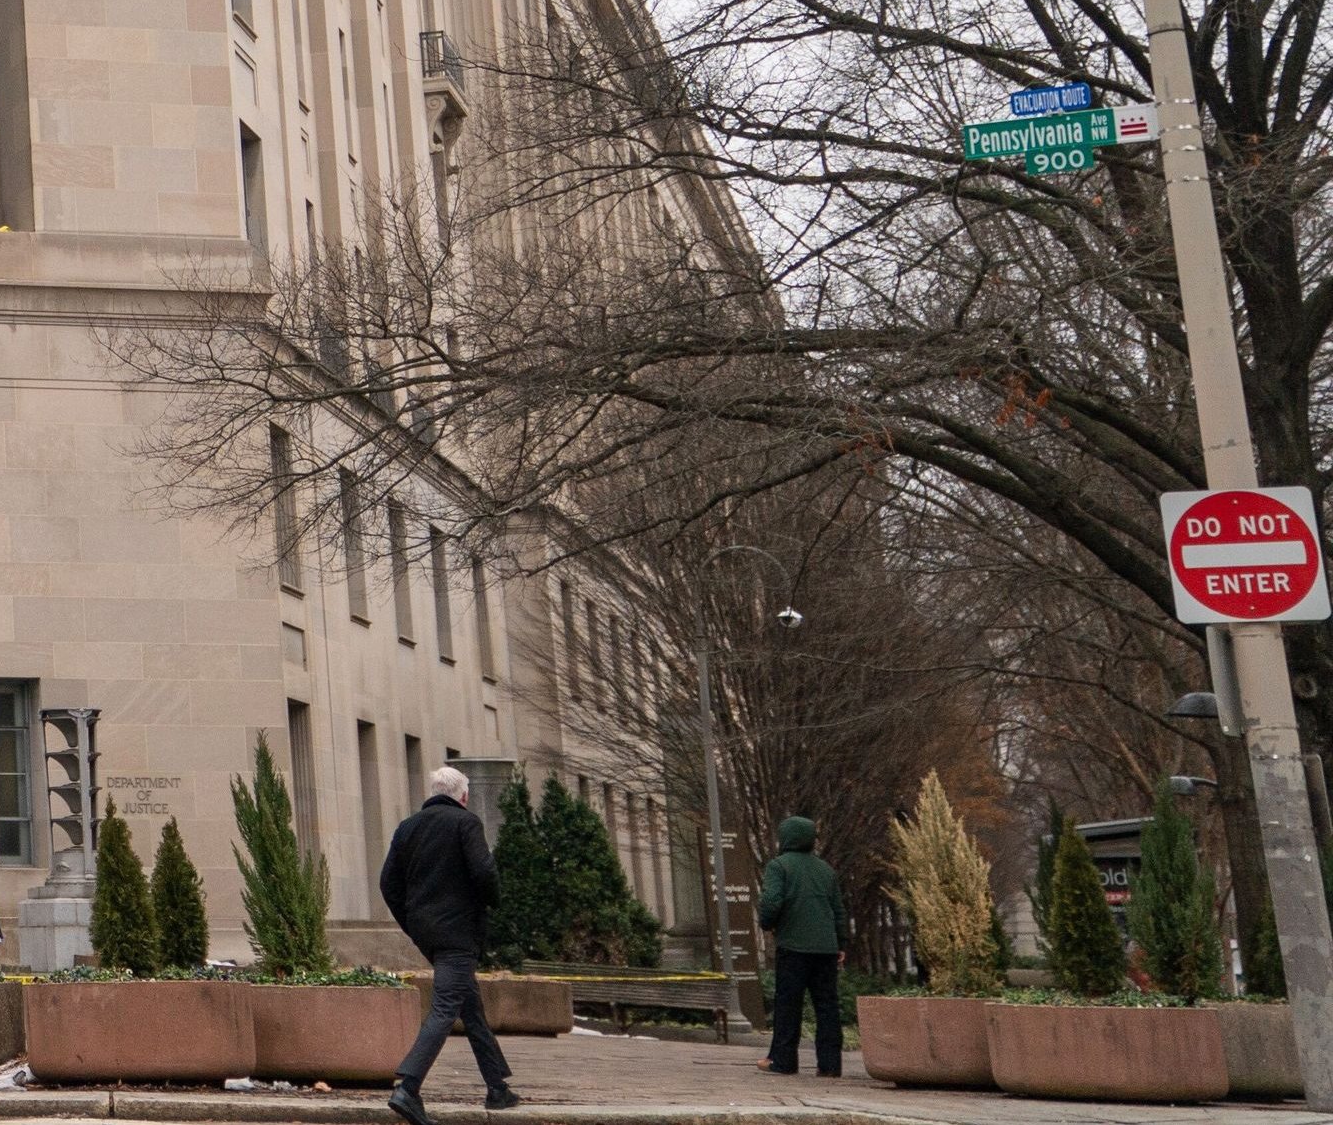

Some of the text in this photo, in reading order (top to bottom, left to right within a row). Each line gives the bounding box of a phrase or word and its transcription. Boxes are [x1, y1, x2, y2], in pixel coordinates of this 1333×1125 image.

[1014, 87, 1087, 113] EVACUATION ROUTE
[968, 114, 1108, 155] Pennsylvania Ave
[1091, 127, 1108, 140] NW
[1034, 150, 1085, 172] 900
[1187, 514, 1290, 537] DO NOT
[1206, 573, 1291, 595] ENTER
[107, 777, 181, 789] DEPARTMENT
[136, 791, 152, 801] OF
[122, 803, 169, 814] JUSTICE
